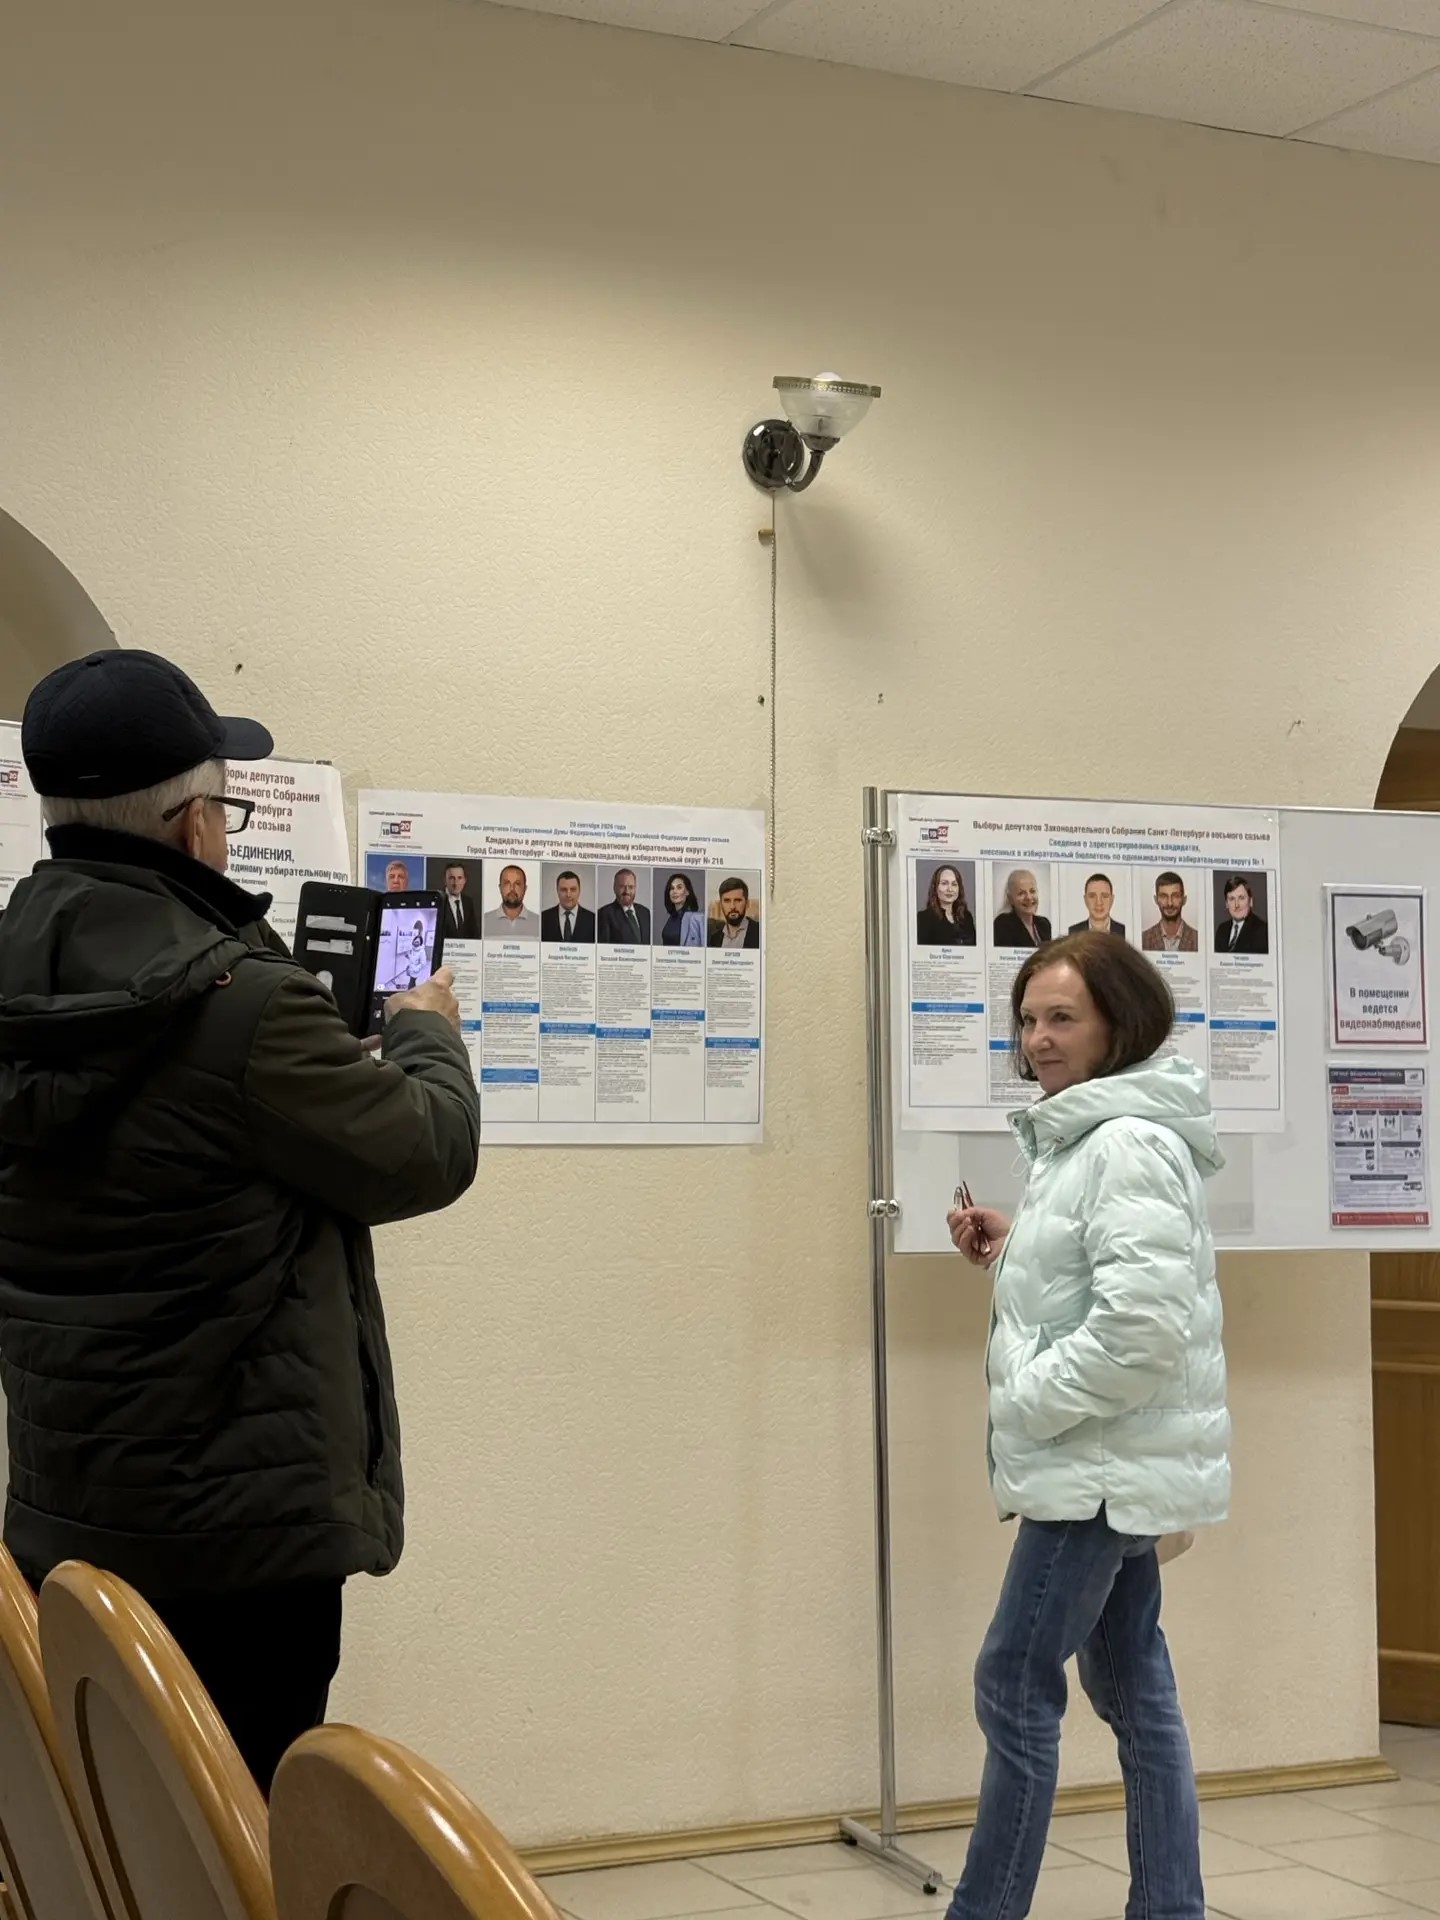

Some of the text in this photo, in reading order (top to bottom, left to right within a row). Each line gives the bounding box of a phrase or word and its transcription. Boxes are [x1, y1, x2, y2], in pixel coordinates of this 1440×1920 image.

[225, 768, 295, 785] боры депутатов
[226, 784, 320, 803] ательного Собрания
[256, 804, 293, 818] ербурга
[257, 821, 291, 833] созыва
[972, 820, 1270, 841] Выборы депутатов Законодательного Собрания Санкт-Петербурга восьмого созыва
[229, 843, 295, 863] ЪЕДИНЕНИЯ,
[485, 836, 523, 846] Кандидаты
[531, 839, 562, 847] депутаты
[574, 842, 629, 851] одномандатному
[631, 843, 684, 854] избирательному
[685, 847, 706, 855] округу
[466, 845, 486, 855] Город
[488, 846, 544, 857] Санкт-Петербург
[551, 849, 576, 858] Южный
[578, 851, 631, 861] одномандатный
[632, 853, 682, 864] избирательный
[230, 862, 263, 876] единому
[265, 865, 332, 880] избирательному
[1349, 987, 1409, 1000] В помещении
[1362, 1004, 1398, 1014] ведется
[1340, 1018, 1421, 1030] видеонаблюдение
